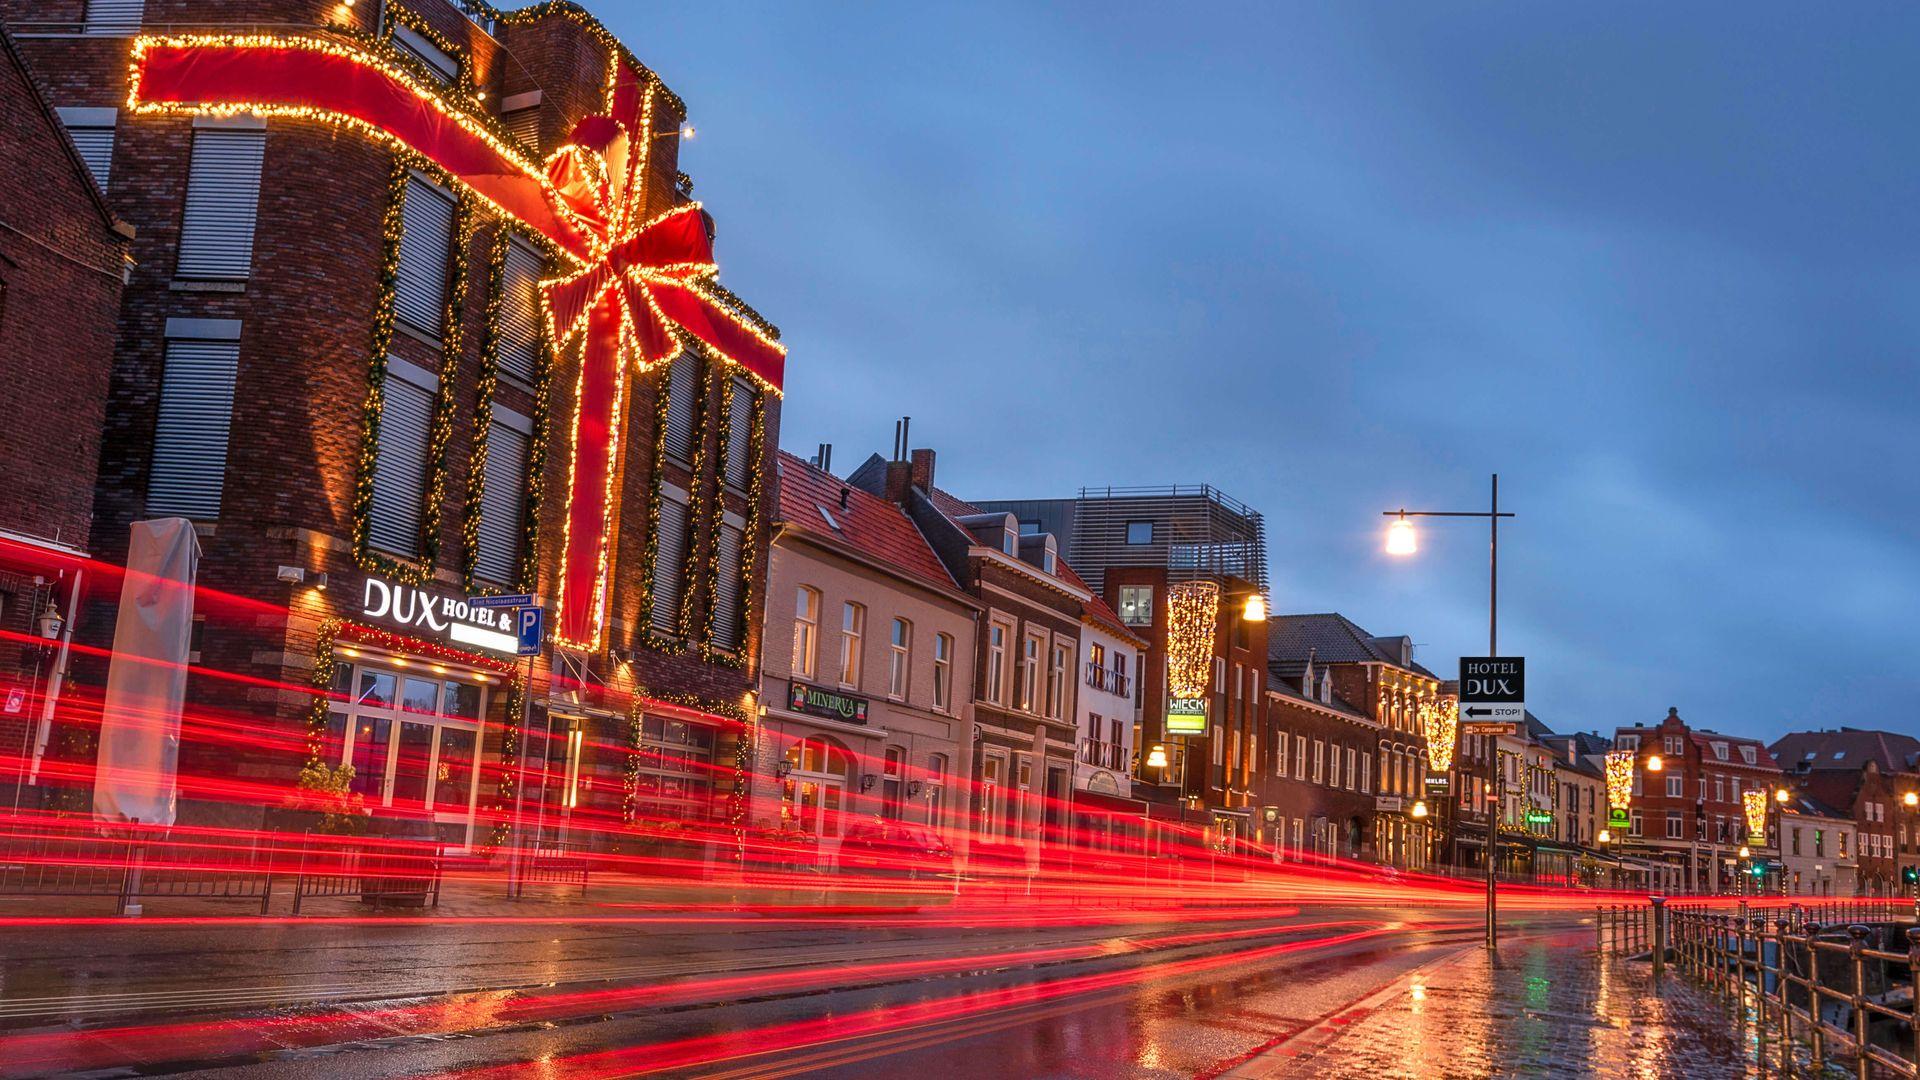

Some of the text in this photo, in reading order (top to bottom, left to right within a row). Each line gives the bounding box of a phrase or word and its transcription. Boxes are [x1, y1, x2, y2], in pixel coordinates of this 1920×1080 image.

[364, 578, 512, 632] DUX HOTEL &
[486, 597, 528, 606] Nicolaasstraat
[522, 611, 537, 636] P
[1468, 663, 1518, 674] HOTEL
[1467, 679, 1518, 695] DUX
[807, 690, 855, 718] MINERVA
[1169, 699, 1204, 710] WIECK
[1494, 708, 1521, 716] STOP!
[1528, 814, 1551, 823] hotel
